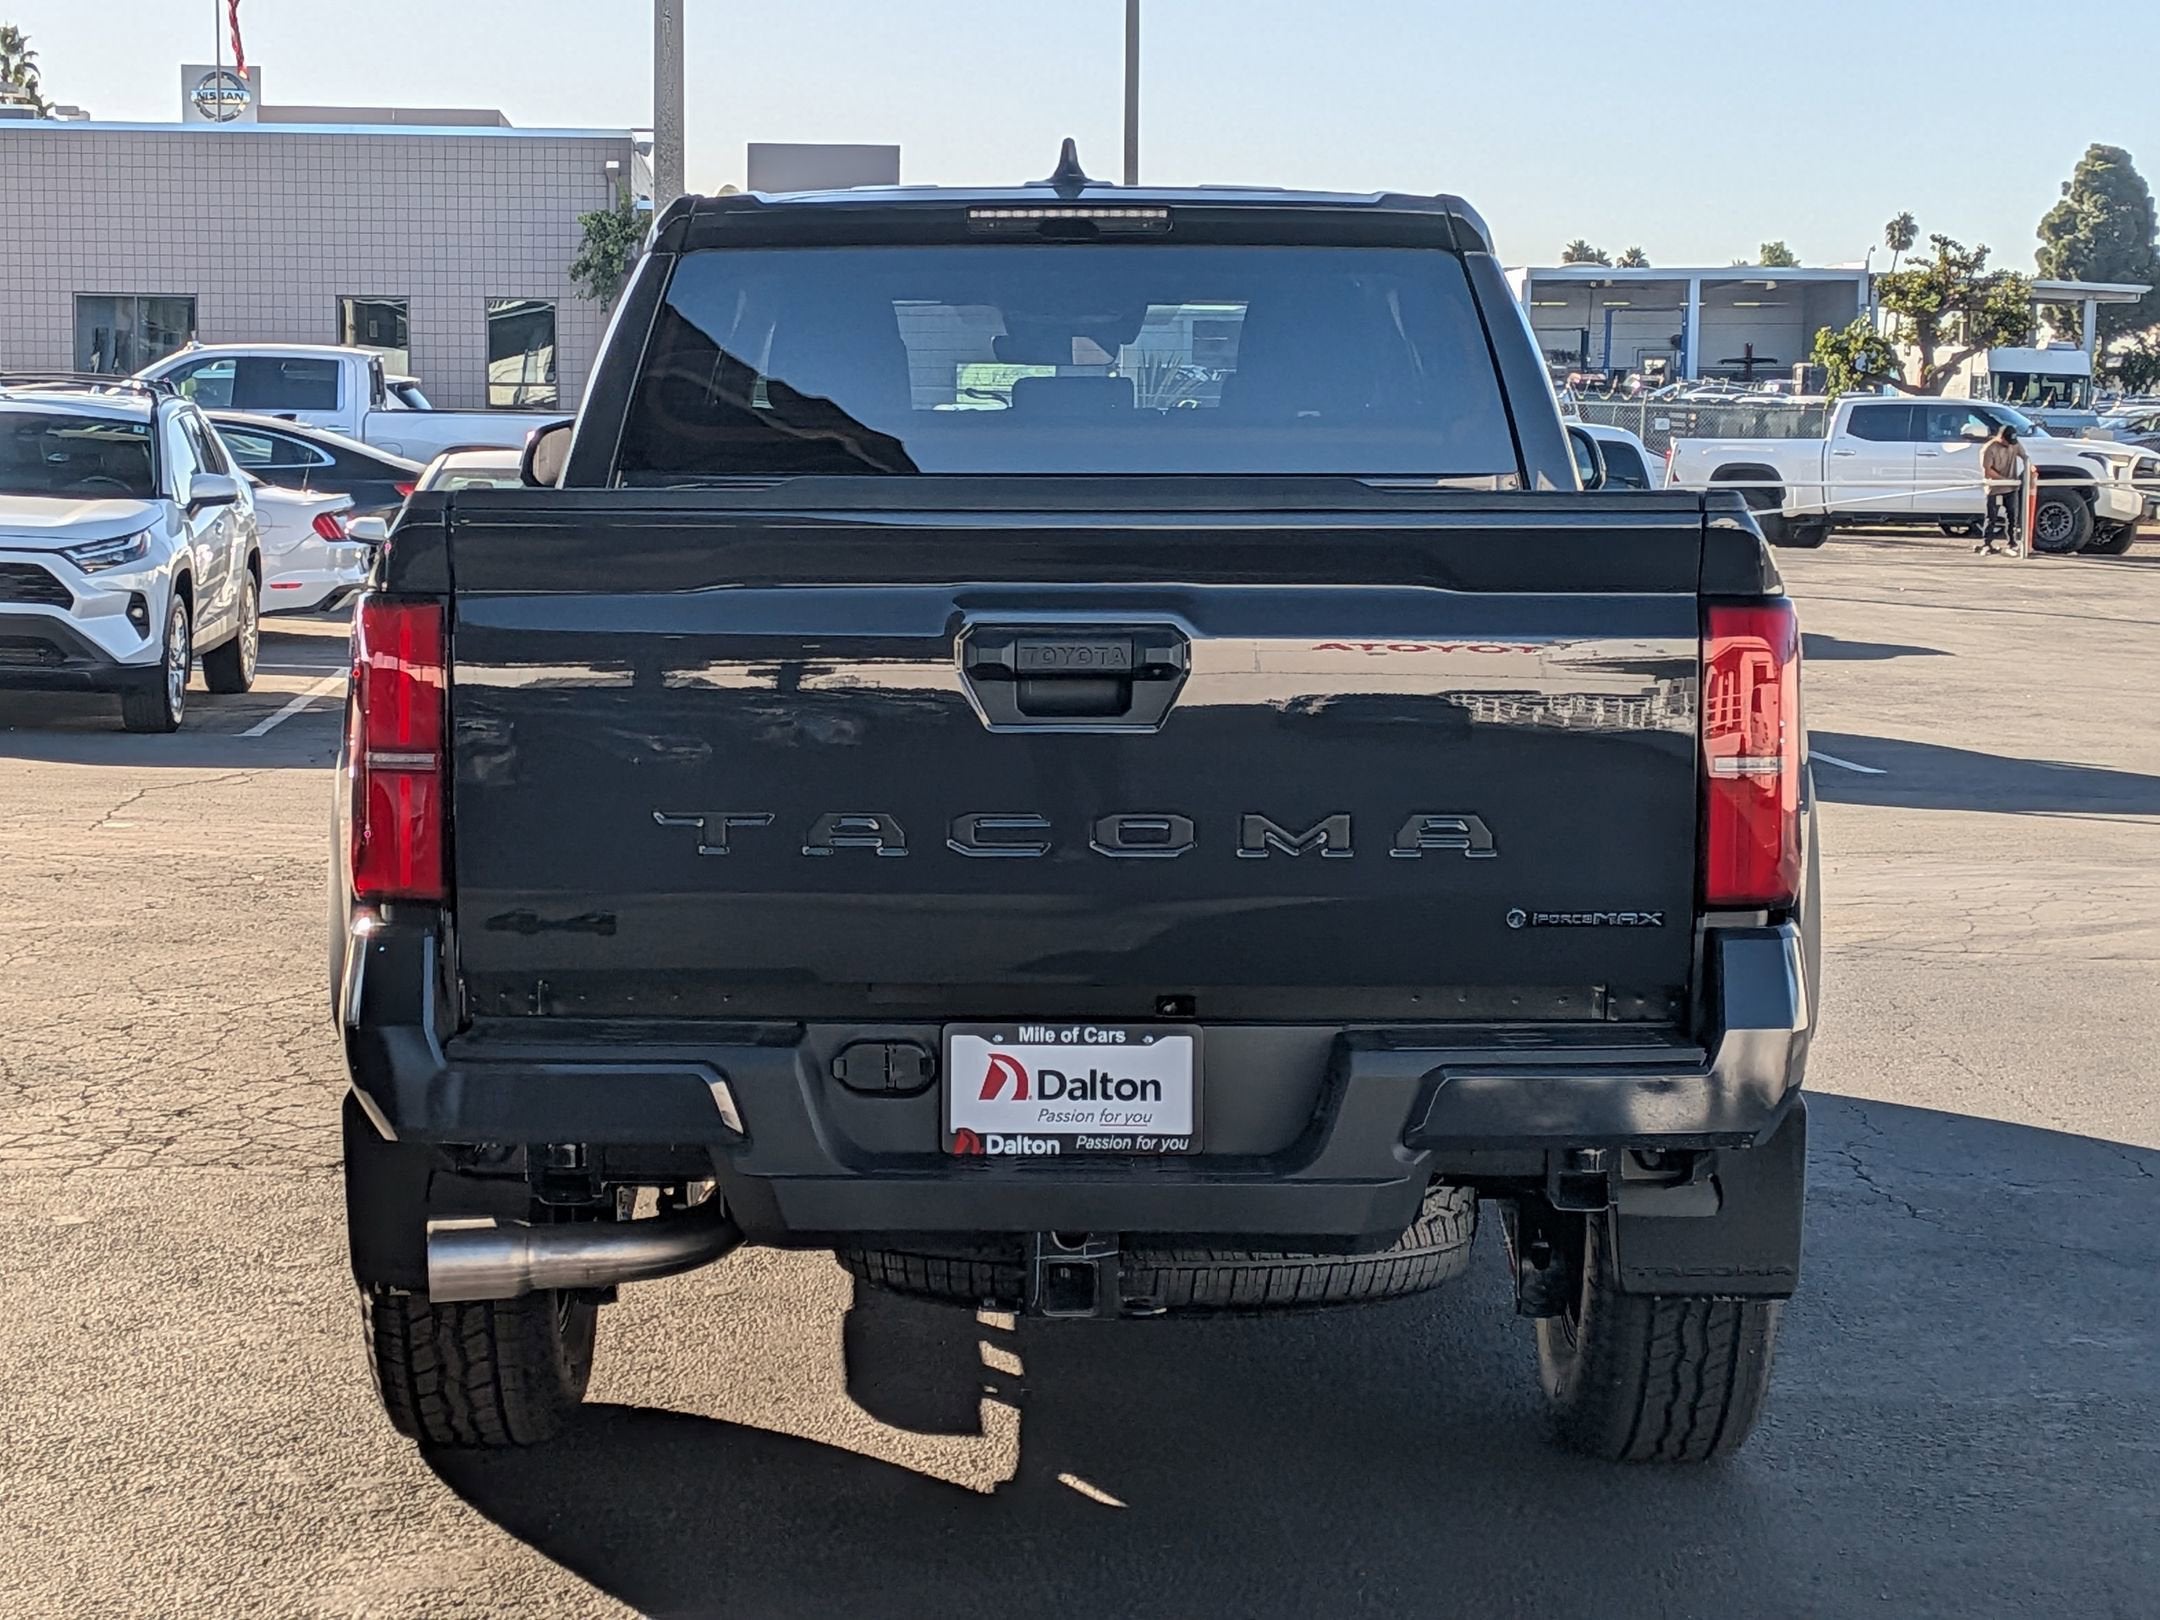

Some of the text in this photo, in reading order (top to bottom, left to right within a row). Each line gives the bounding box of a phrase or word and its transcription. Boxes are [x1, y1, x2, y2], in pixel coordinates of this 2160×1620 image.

[1023, 646, 1128, 666] TOYOTA
[652, 811, 1498, 857] TACOMA
[1018, 1026, 1127, 1043] Mile of Cars
[1037, 1069, 1162, 1102] Dalton
[1036, 1108, 1153, 1125] Passion for you
[986, 1134, 1061, 1155] Dalton
[1075, 1135, 1190, 1153] Passion for you
